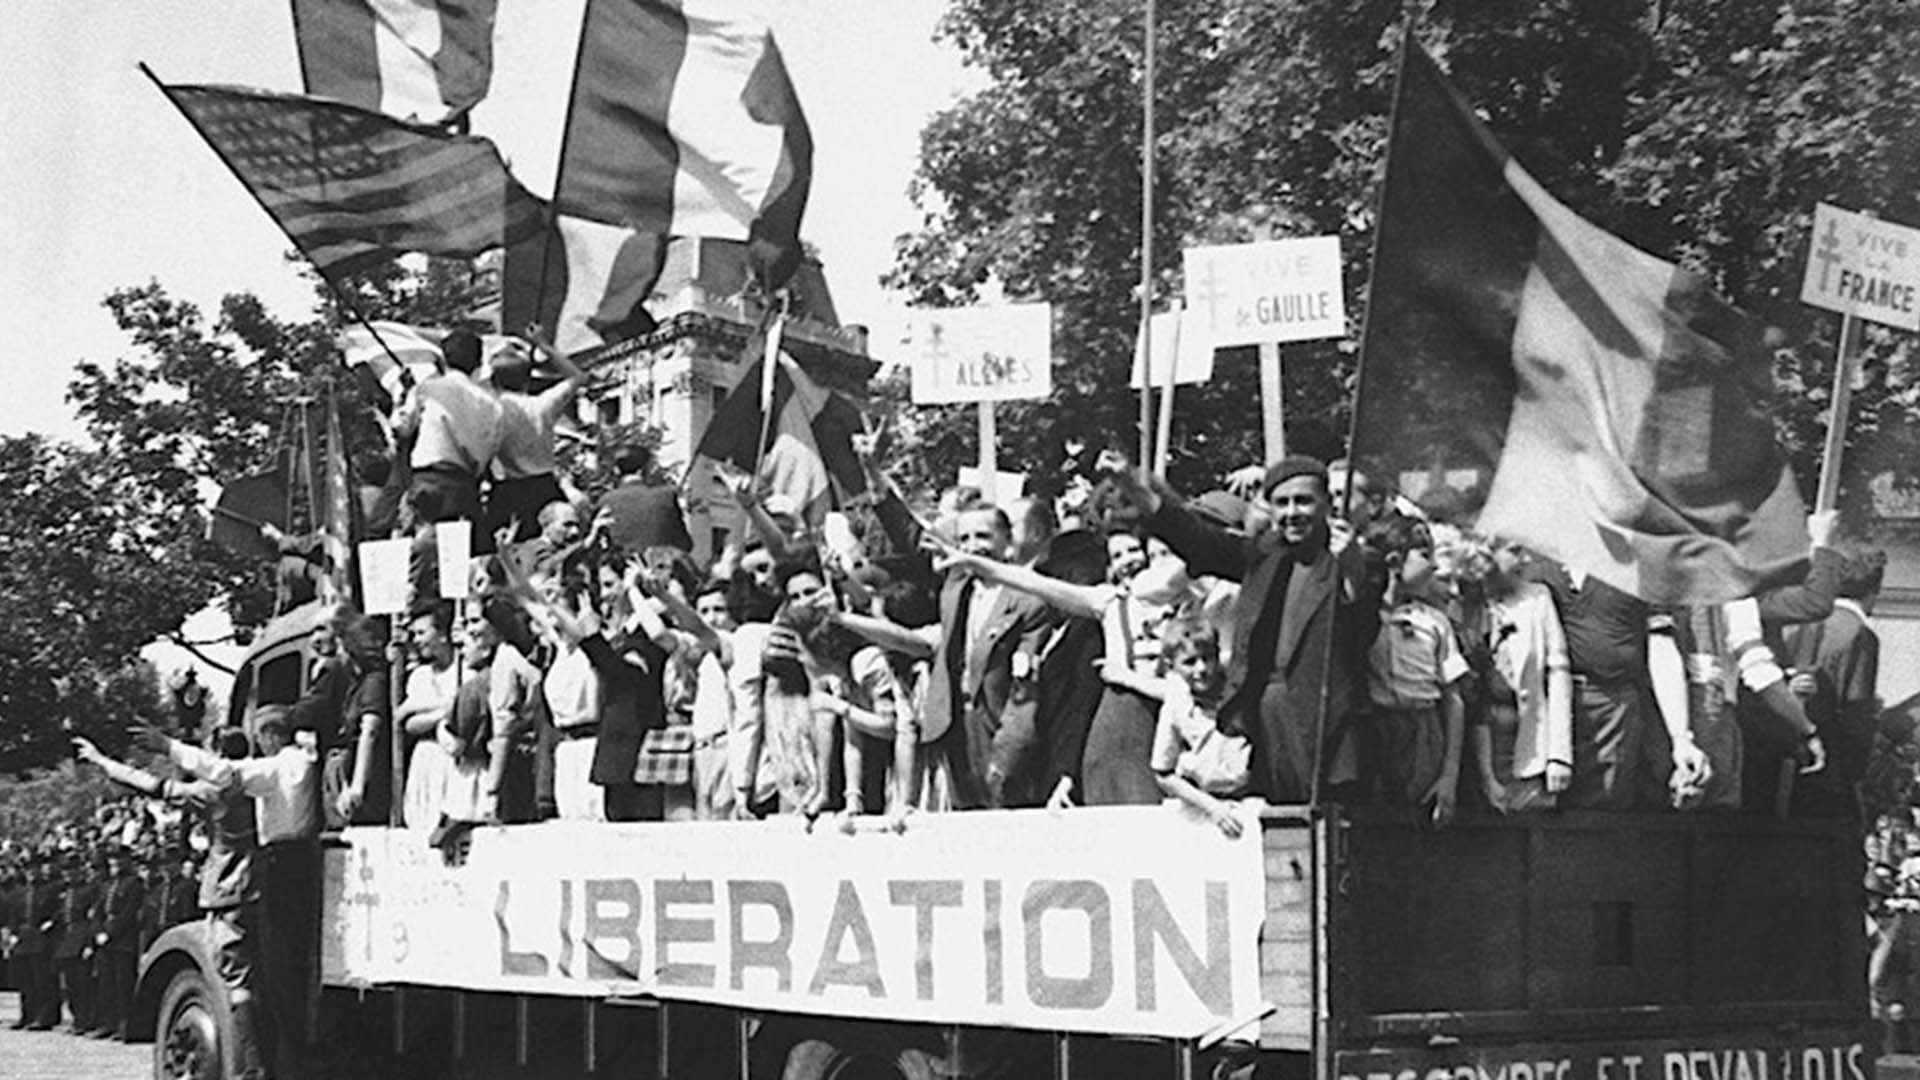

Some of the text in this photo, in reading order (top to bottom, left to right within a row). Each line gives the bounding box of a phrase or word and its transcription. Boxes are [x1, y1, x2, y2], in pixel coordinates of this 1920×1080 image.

[1856, 232, 1909, 258] VIVE
[1245, 256, 1314, 279] VIVE
[1838, 269, 1915, 313] FRANCE
[1257, 291, 1331, 326] GAULLE
